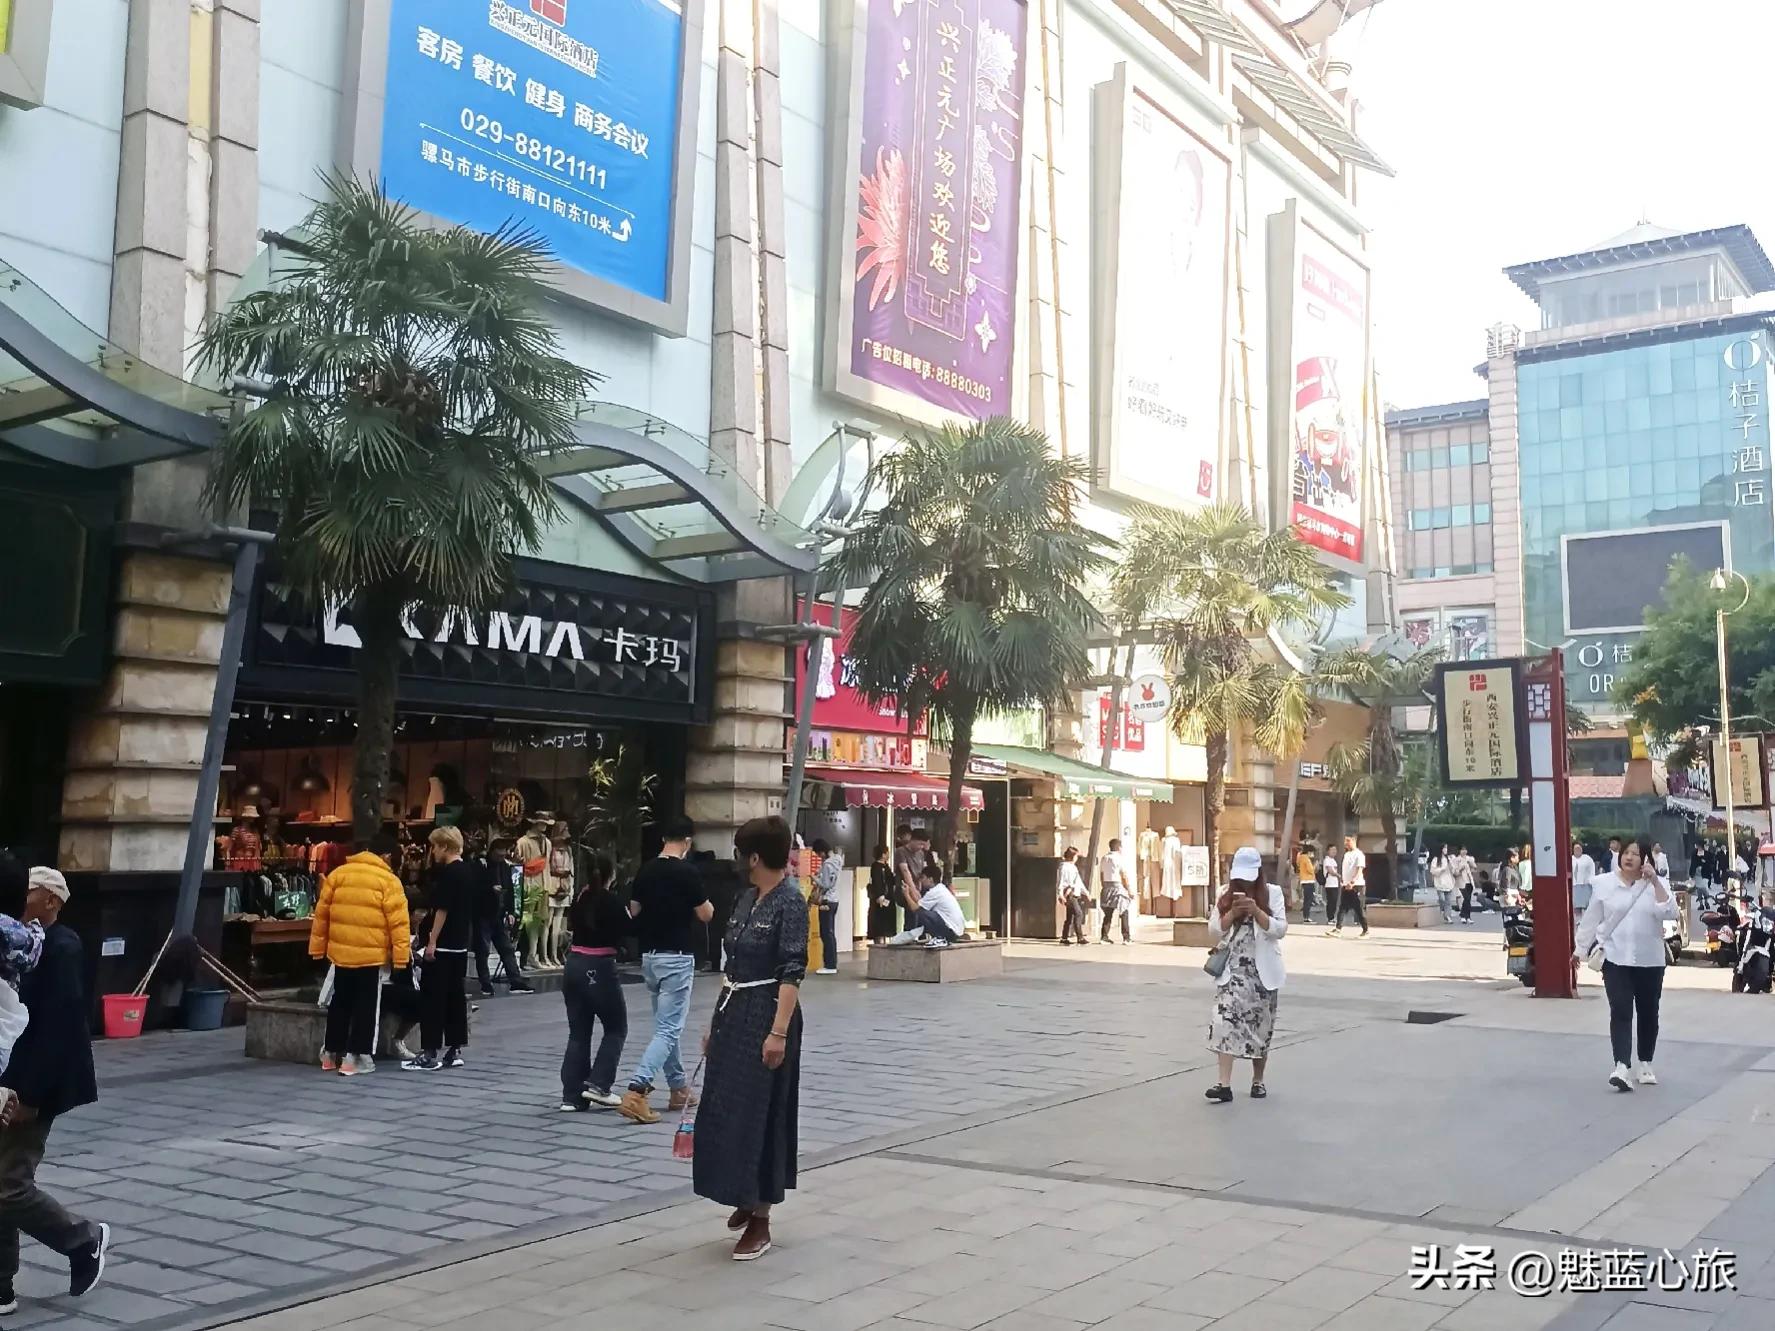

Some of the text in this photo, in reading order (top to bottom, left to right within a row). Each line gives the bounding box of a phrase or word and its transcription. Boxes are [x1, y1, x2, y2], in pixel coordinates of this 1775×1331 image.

[417, 25, 649, 159] 客房 餐饮 健身 商务会议
[420, 139, 612, 236] 骡马市步行街南口向东10米
[460, 107, 607, 190] 029-88121111
[1728, 379, 1764, 507] 桔子酒店
[603, 626, 680, 673] 卡玛
